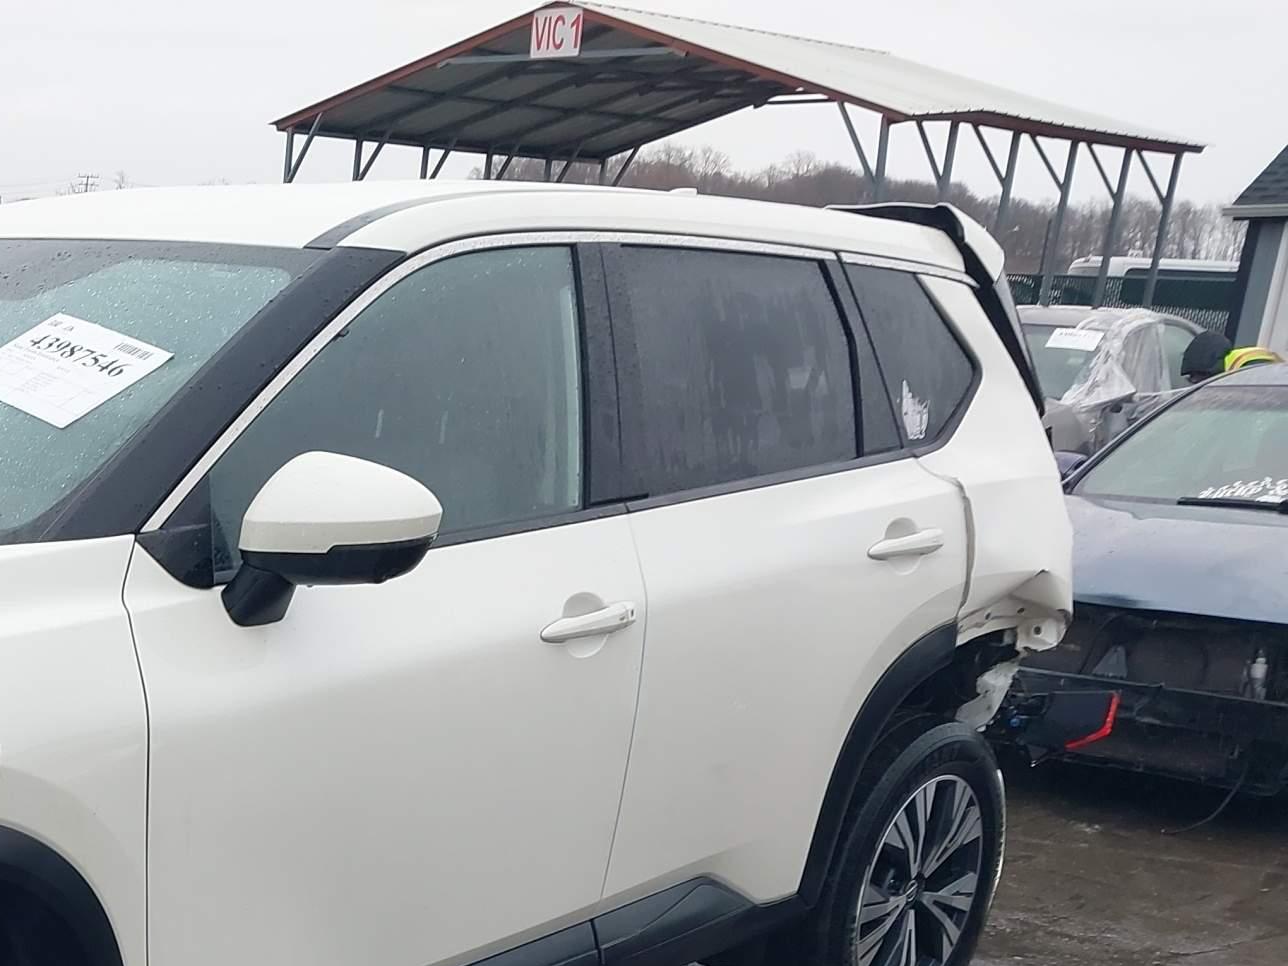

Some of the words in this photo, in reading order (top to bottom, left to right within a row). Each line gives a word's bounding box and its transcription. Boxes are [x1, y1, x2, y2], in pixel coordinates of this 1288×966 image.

[535, 15, 565, 50] VIC
[571, 13, 581, 49] 1
[29, 334, 133, 377] 43987546
